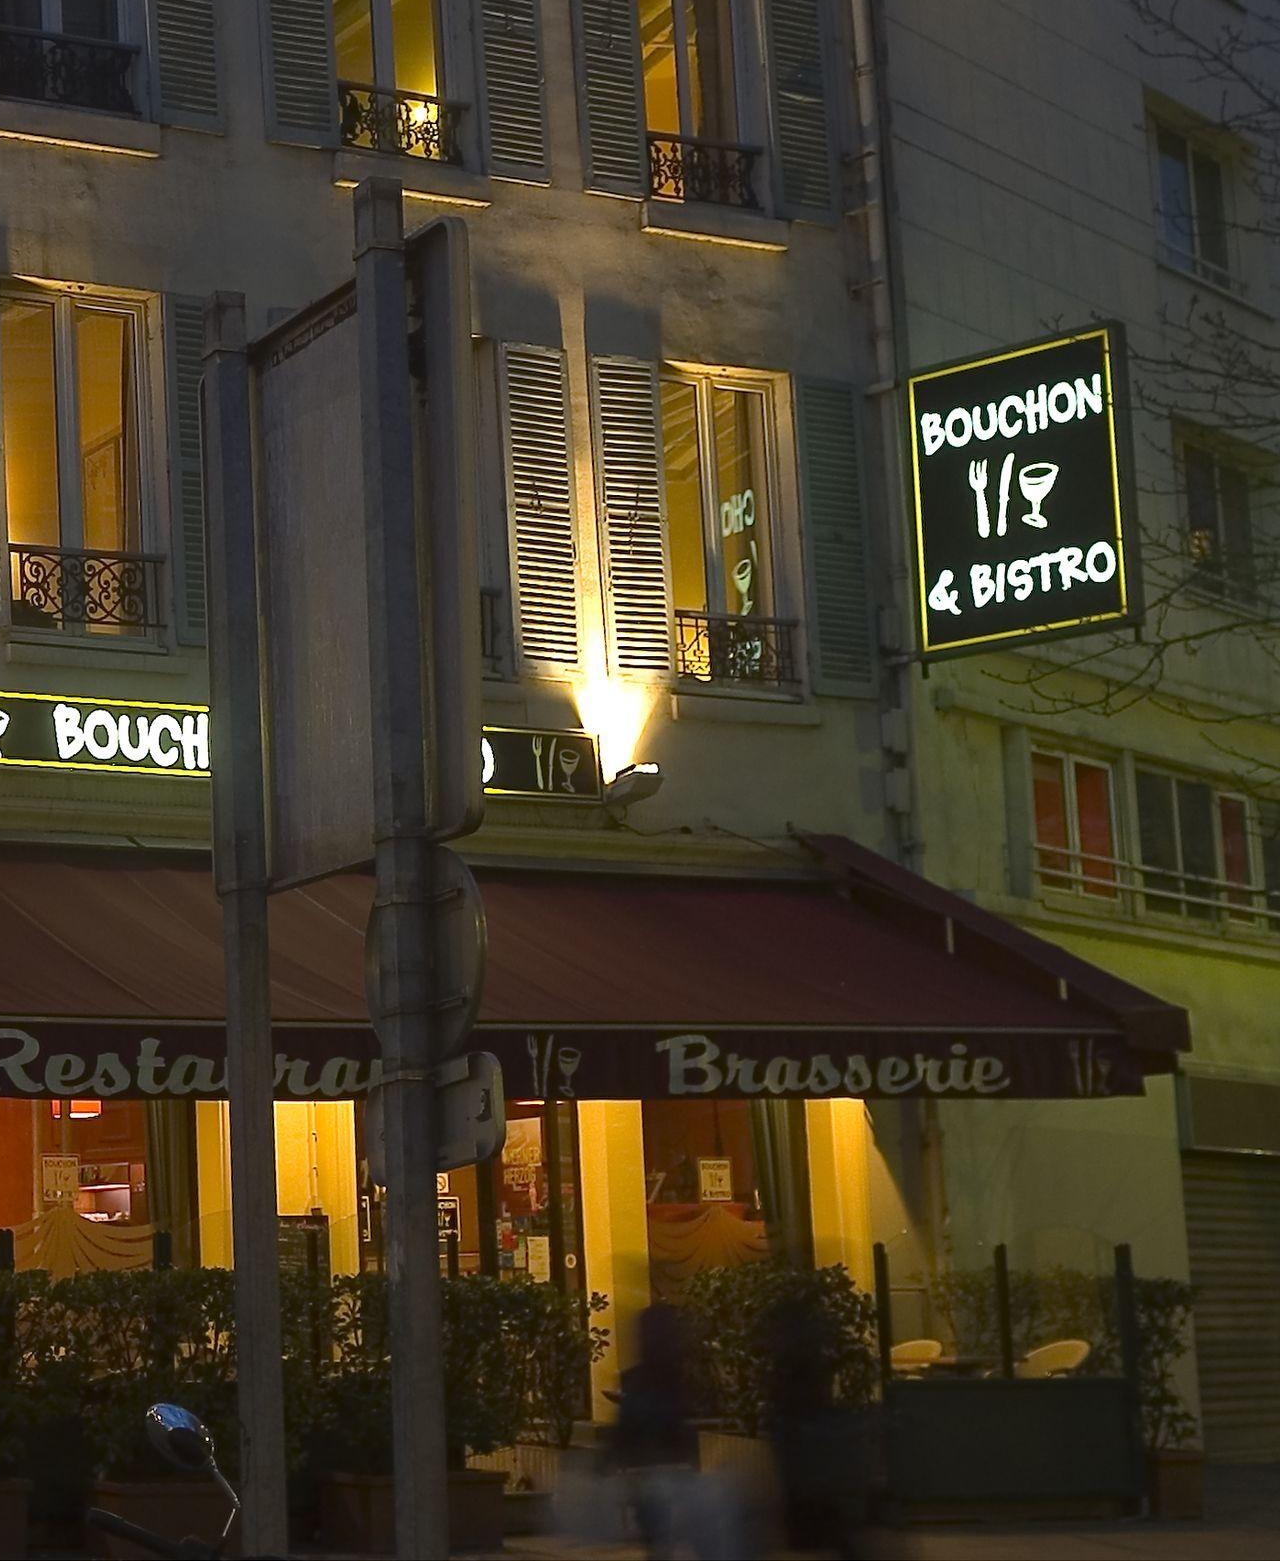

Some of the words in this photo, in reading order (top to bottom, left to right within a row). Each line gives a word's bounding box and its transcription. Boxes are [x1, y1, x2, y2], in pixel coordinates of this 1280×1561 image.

[921, 373, 1103, 456] BOUCHON
[928, 570, 962, 615] &
[970, 541, 1116, 608] BISTRO
[53, 703, 209, 770] BOUCH
[655, 1034, 1011, 1095] Brasserie
